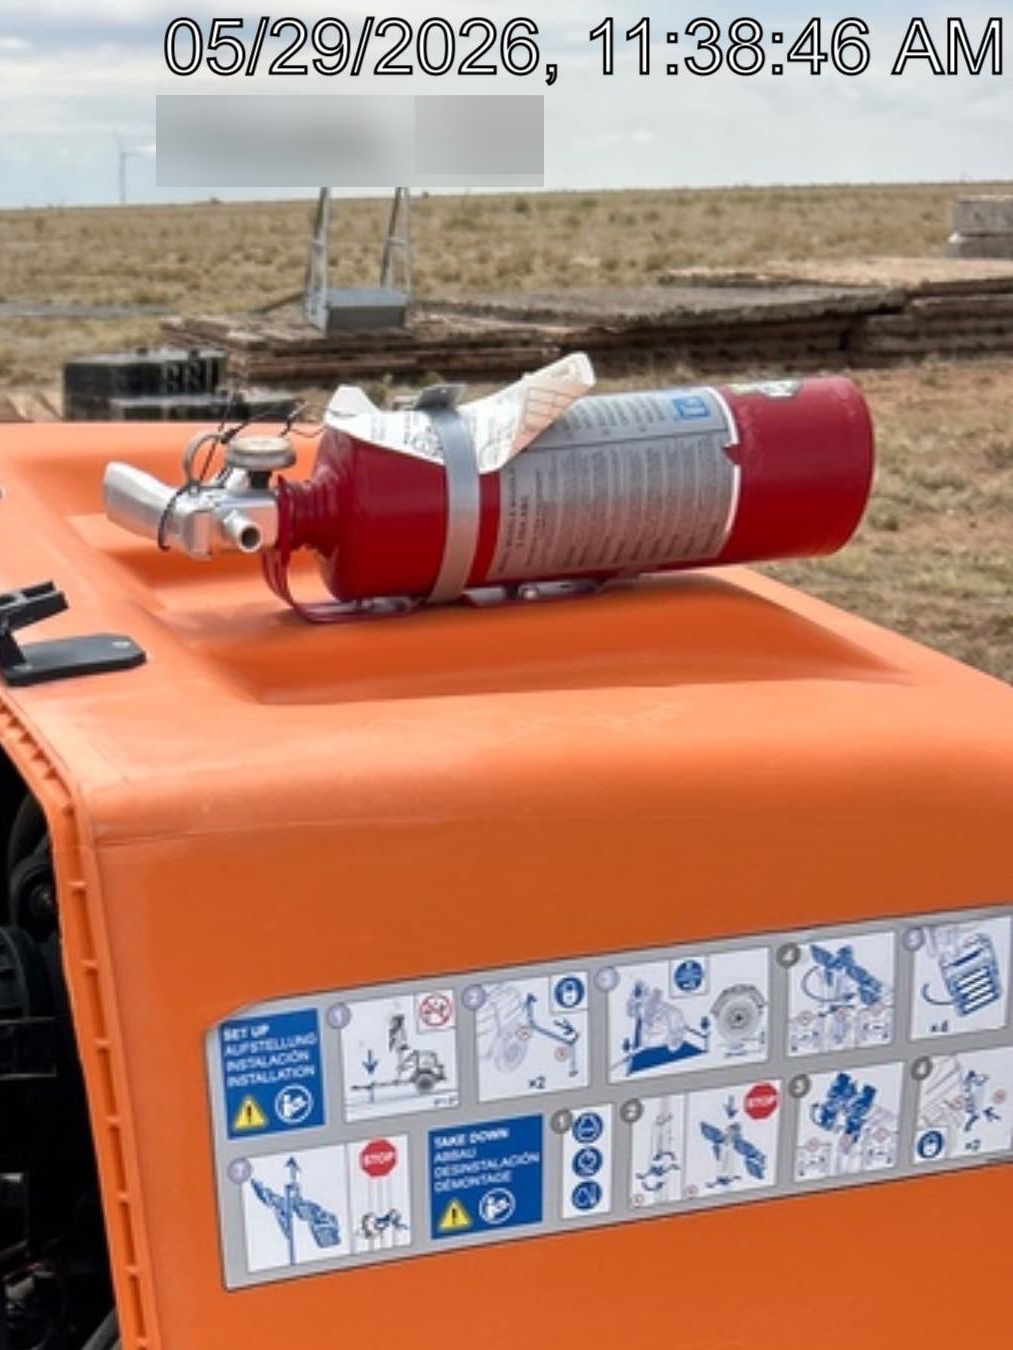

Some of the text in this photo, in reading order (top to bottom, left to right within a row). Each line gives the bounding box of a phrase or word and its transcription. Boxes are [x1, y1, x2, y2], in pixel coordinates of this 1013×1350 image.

[223, 1024, 269, 1041] SET UP
[224, 1032, 317, 1056] AUFSTELLUNG
[226, 1064, 315, 1087] INSTALLATION
[748, 1095, 775, 1108] STOP
[433, 1127, 510, 1149] TAKE DOWN
[364, 1151, 395, 1166] STOP
[434, 1148, 477, 1163] ABBAU
